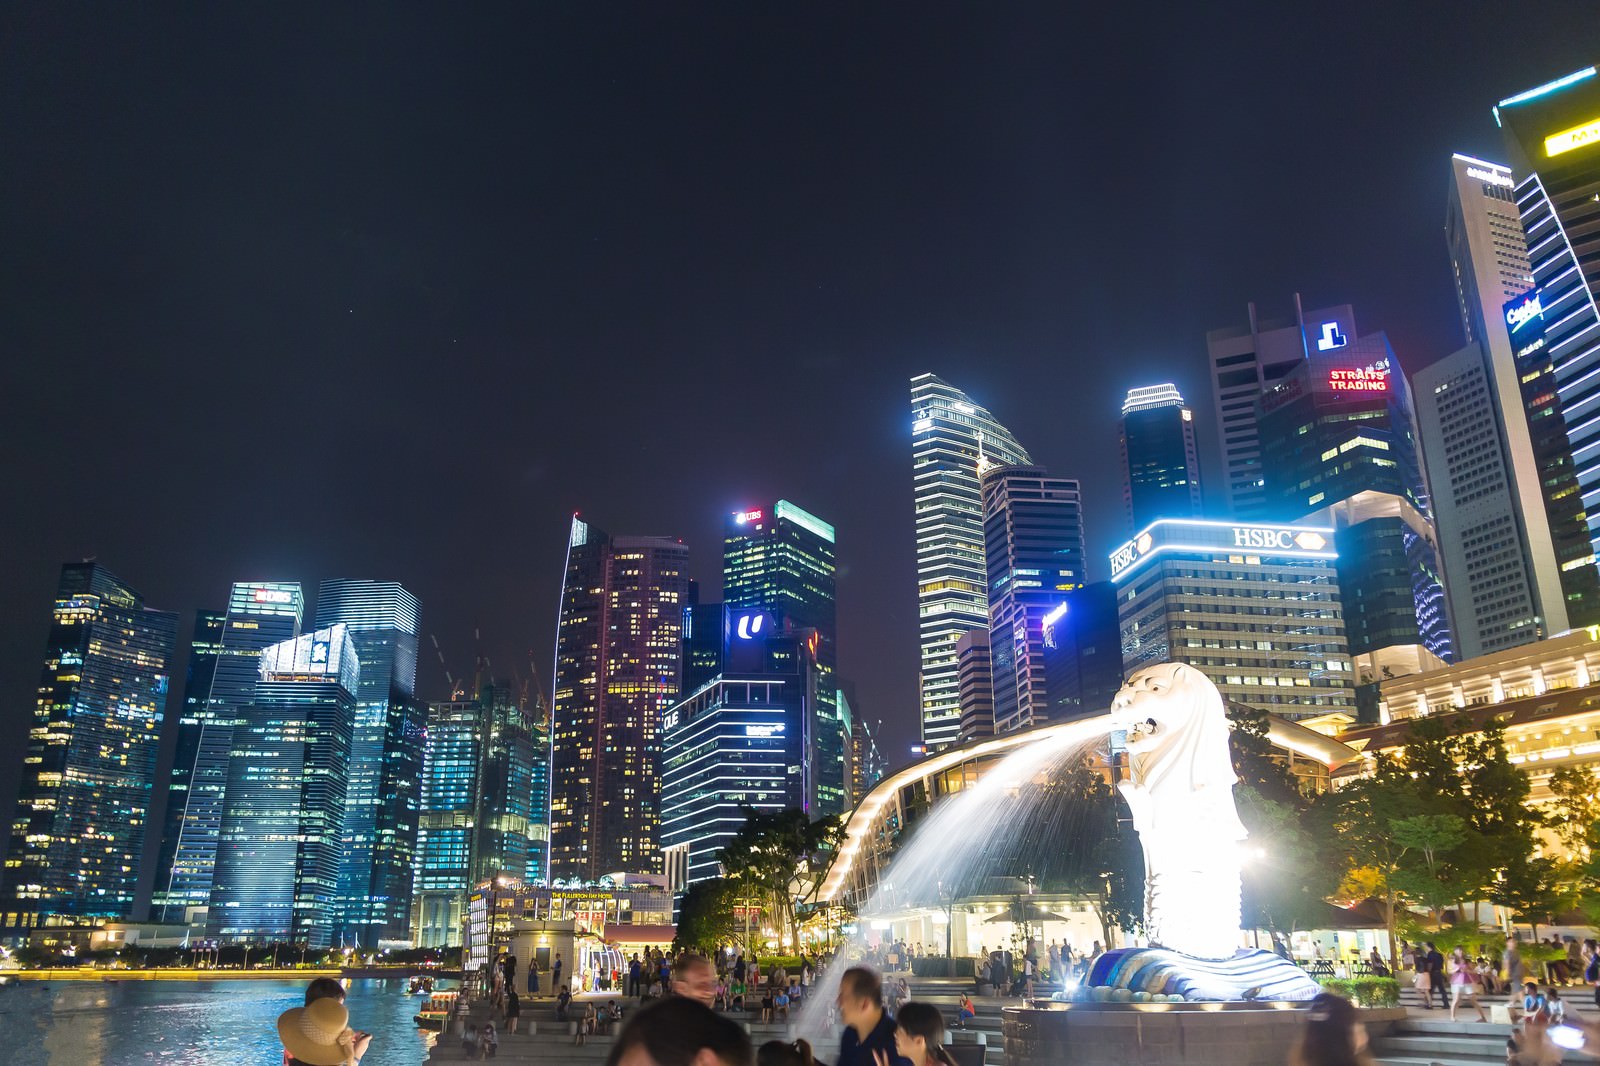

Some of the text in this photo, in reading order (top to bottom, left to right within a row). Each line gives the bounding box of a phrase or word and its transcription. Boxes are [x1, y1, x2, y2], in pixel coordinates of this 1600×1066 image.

[1331, 370, 1385, 380] STRAITS
[1329, 380, 1386, 390] TRADING
[1232, 527, 1293, 549] HSBC
[1110, 541, 1138, 576] HSBC
